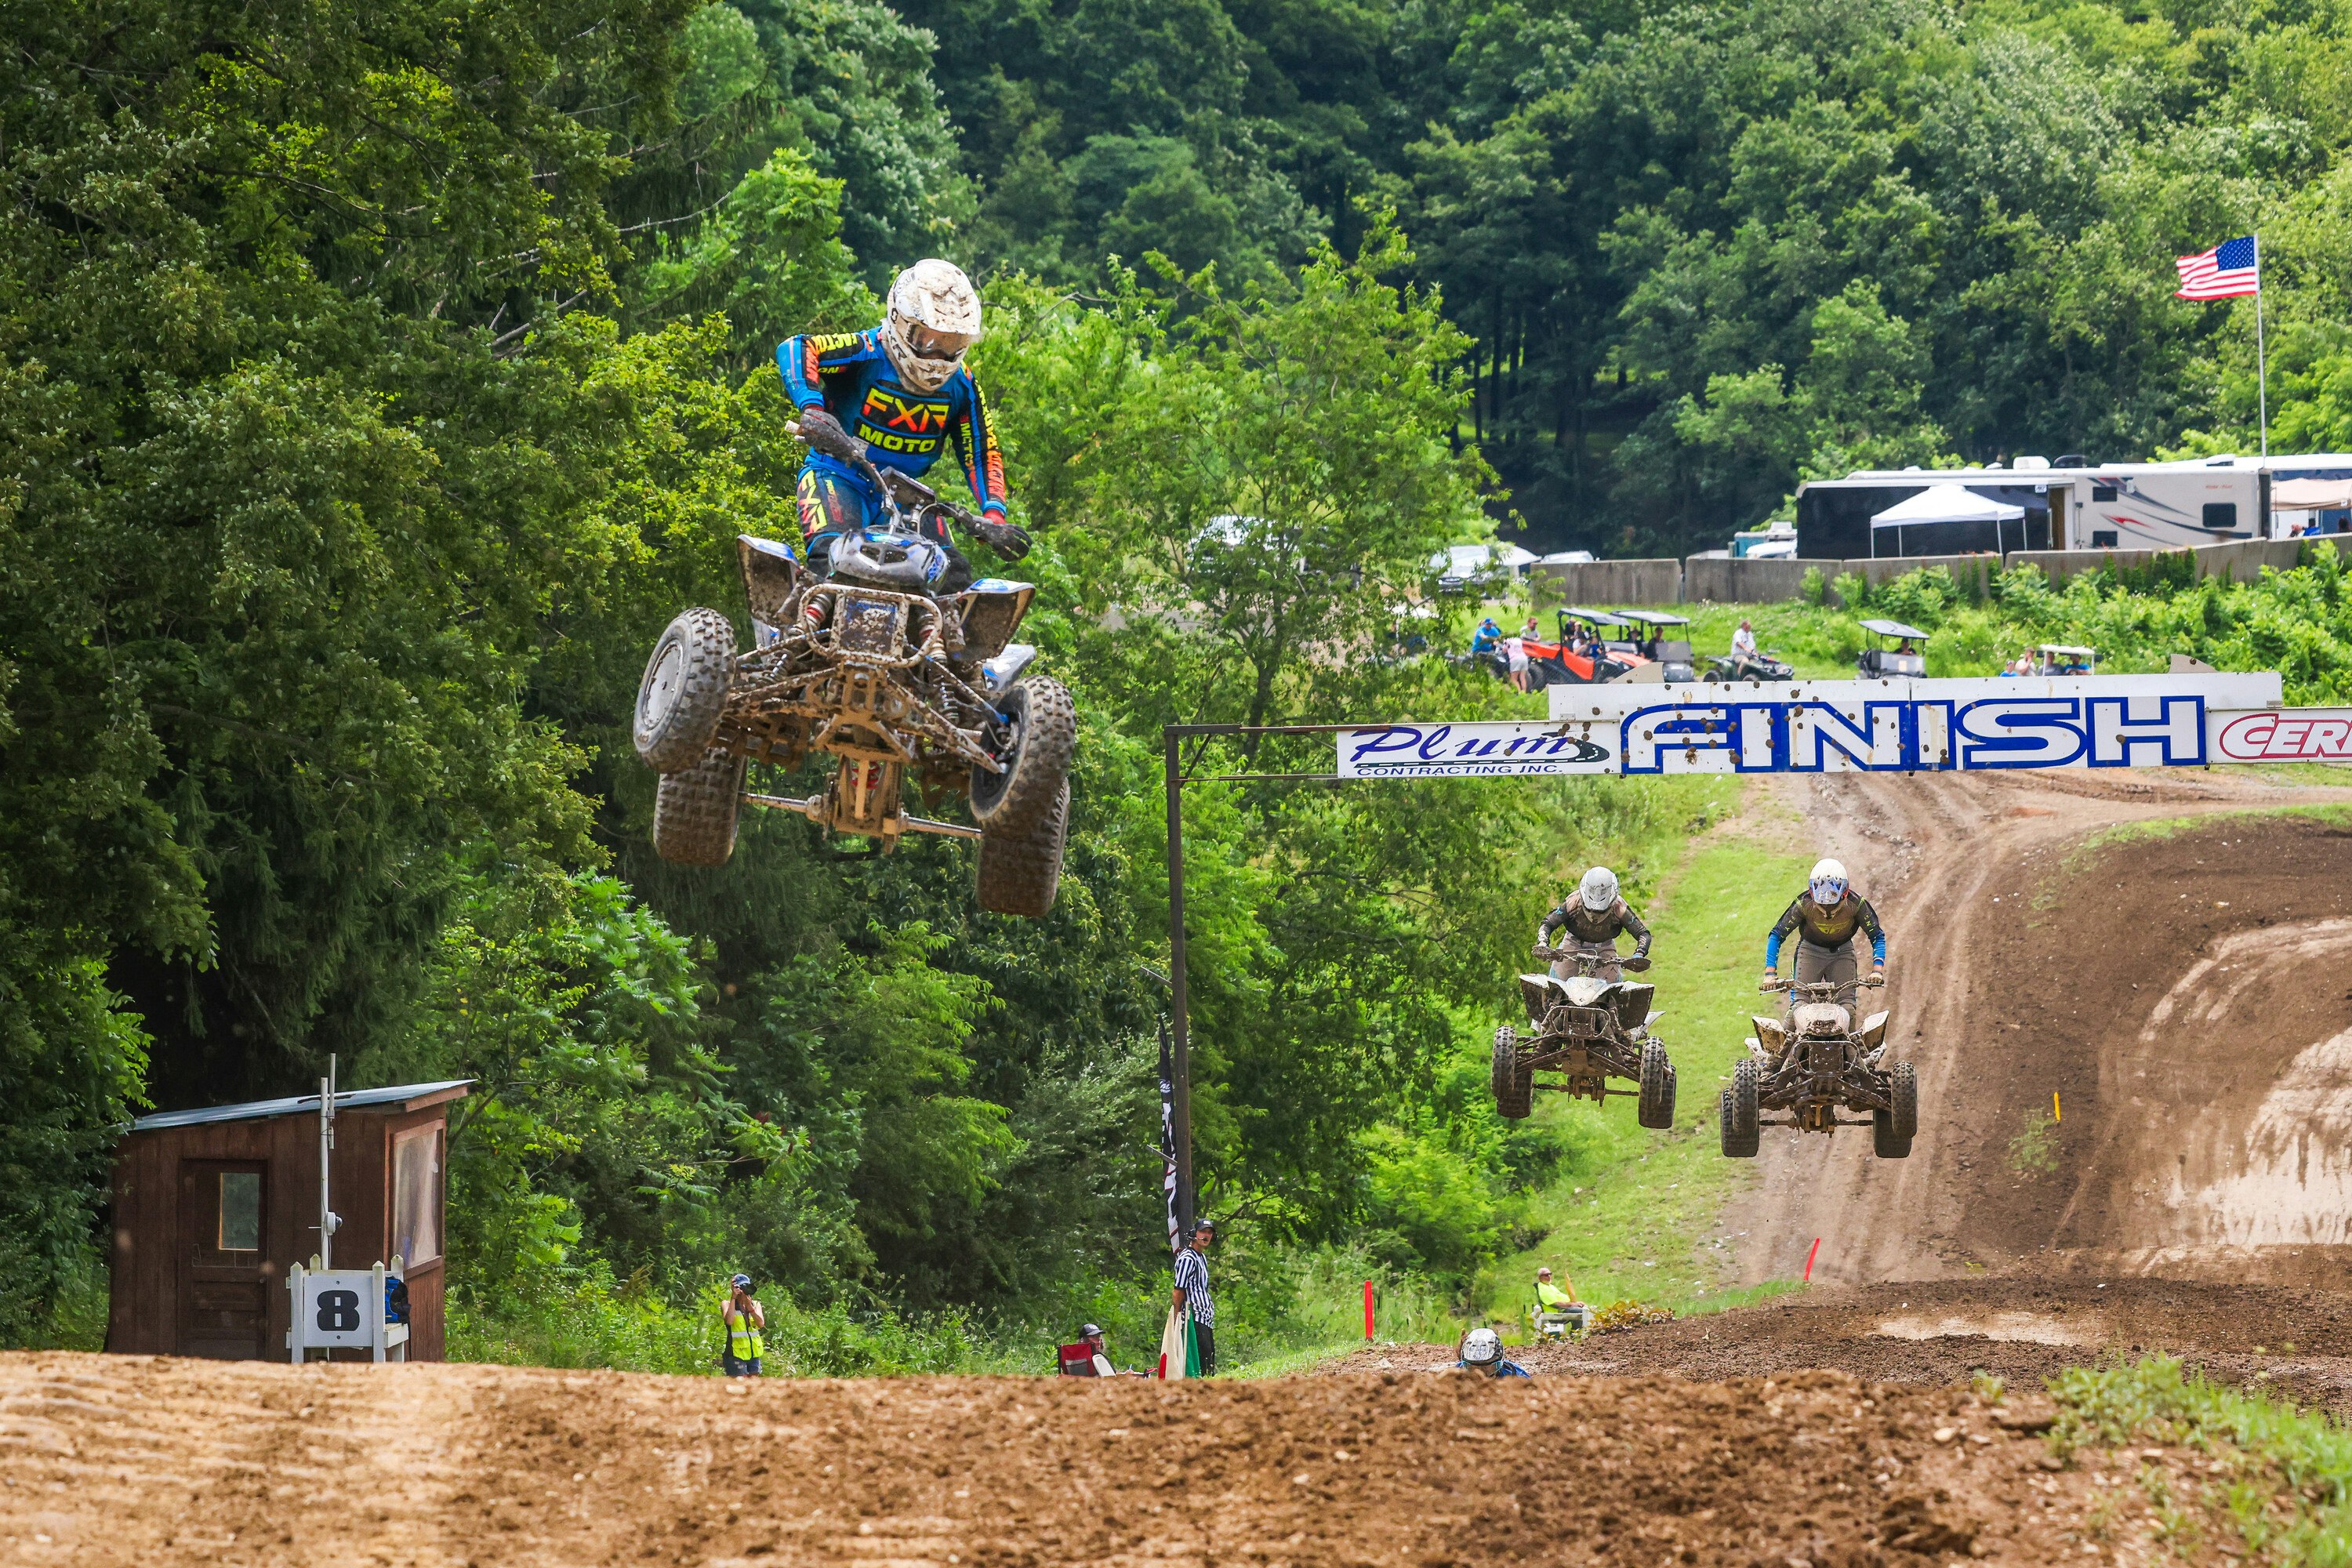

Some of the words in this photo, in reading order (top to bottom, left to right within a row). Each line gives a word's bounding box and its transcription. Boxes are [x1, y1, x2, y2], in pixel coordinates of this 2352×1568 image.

[863, 388, 949, 432] FXR
[858, 423, 936, 453] MOTO
[1350, 725, 1570, 761] Plum
[1620, 695, 2206, 774] FINISH
[2220, 713, 2352, 760] CER
[1357, 765, 1512, 776] CONTRACTING
[1520, 764, 1563, 774] INC.
[317, 1290, 360, 1331] 8
